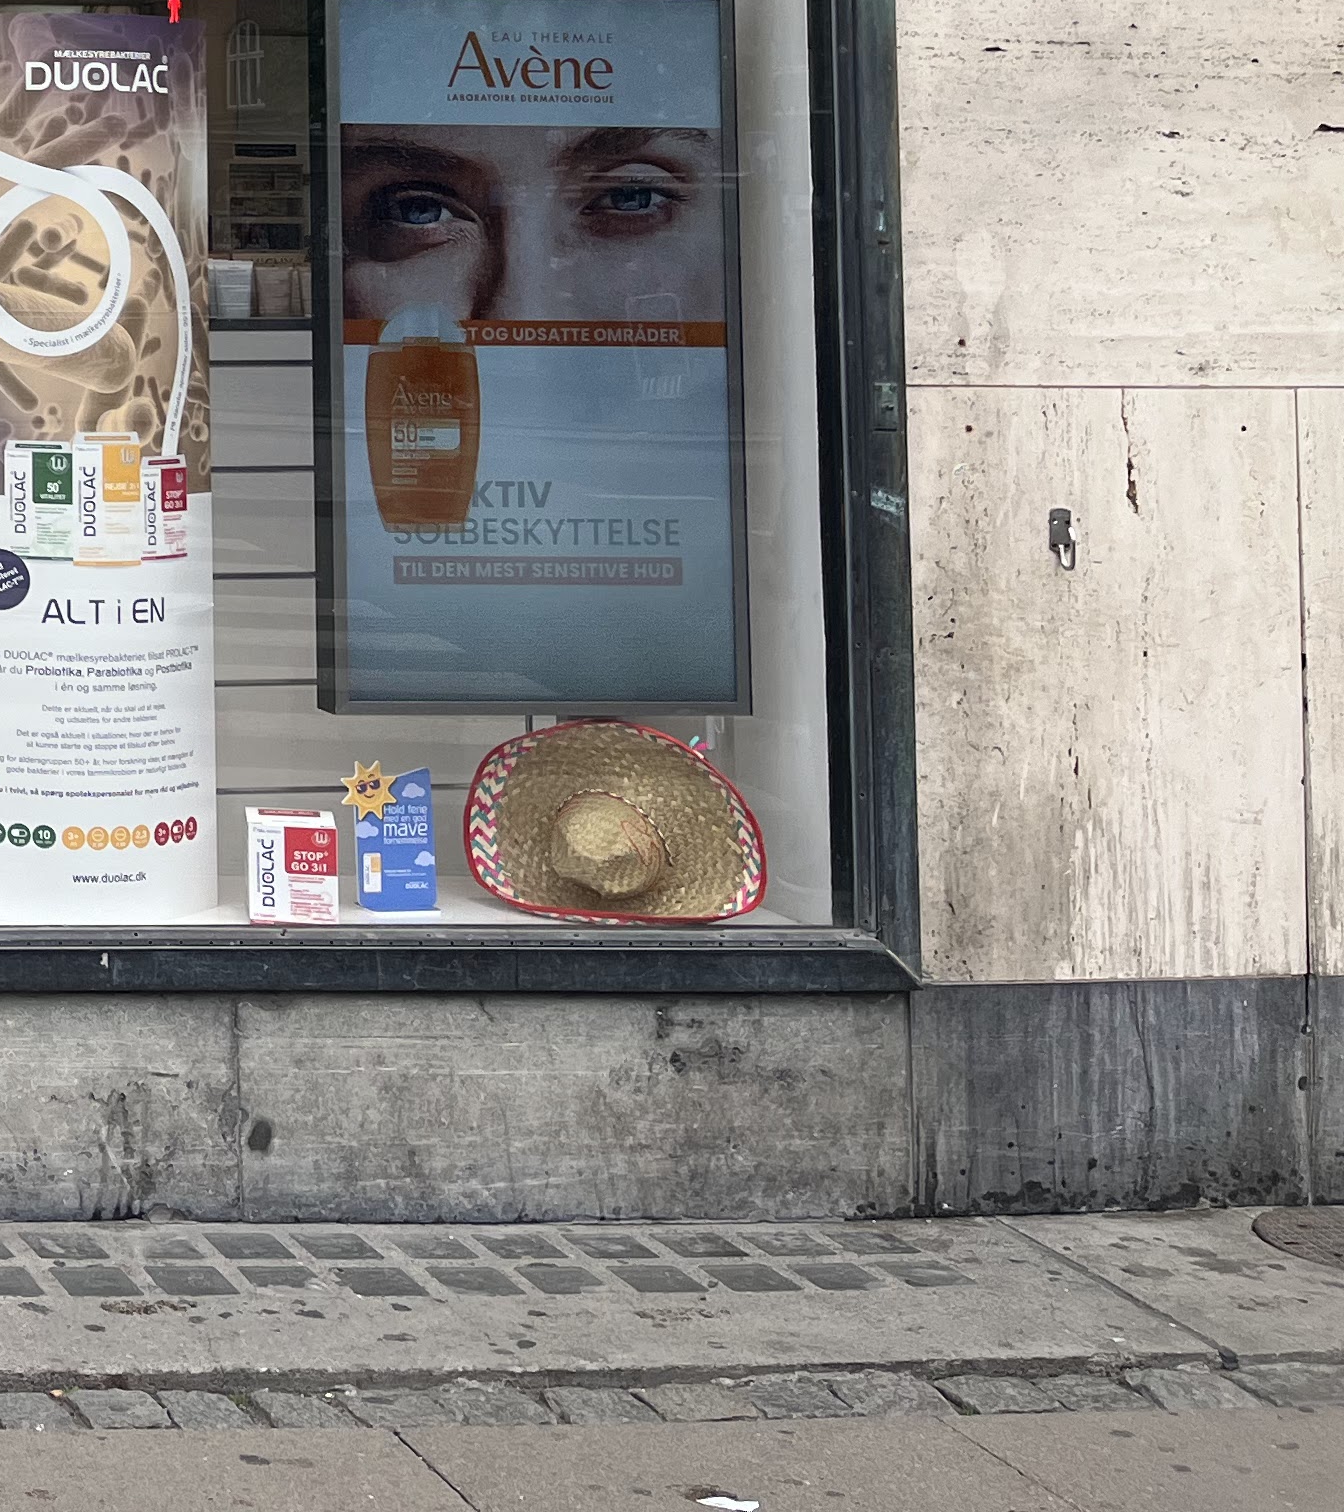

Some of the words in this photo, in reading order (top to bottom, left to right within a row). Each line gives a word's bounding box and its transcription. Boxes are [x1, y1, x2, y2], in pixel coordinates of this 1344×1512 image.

[491, 31, 522, 42] EAU
[532, 32, 613, 44] THERMALE
[448, 31, 613, 90] Avène
[25, 61, 169, 94] DUOLAC
[447, 94, 515, 103] LABORATOIRE
[520, 94, 614, 104] DERMATOLOGIQUE
[27, 333, 69, 349] Specialist
[481, 327, 507, 341] OG
[513, 327, 590, 341] UDSATTE
[14, 470, 26, 533] DUOLAC
[83, 467, 96, 536] DUOLAC
[148, 481, 157, 545] DUOLAC
[401, 561, 426, 577] TIL
[433, 562, 469, 577] DEN
[484, 562, 526, 577] MEST
[532, 562, 628, 578] SENSITIVE
[634, 563, 674, 578] HUD
[41, 599, 105, 624] ALT
[132, 597, 165, 624] EN
[9, 664, 23, 675] du
[76, 683, 89, 694] og
[92, 683, 125, 692] samme
[384, 804, 404, 815] Hold
[407, 804, 428, 815] ferie
[384, 822, 428, 837] mave
[294, 850, 323, 861] STOP
[262, 839, 274, 907] DUOLAC
[291, 862, 308, 872] GO
[72, 871, 147, 884] www.duolac.dk
